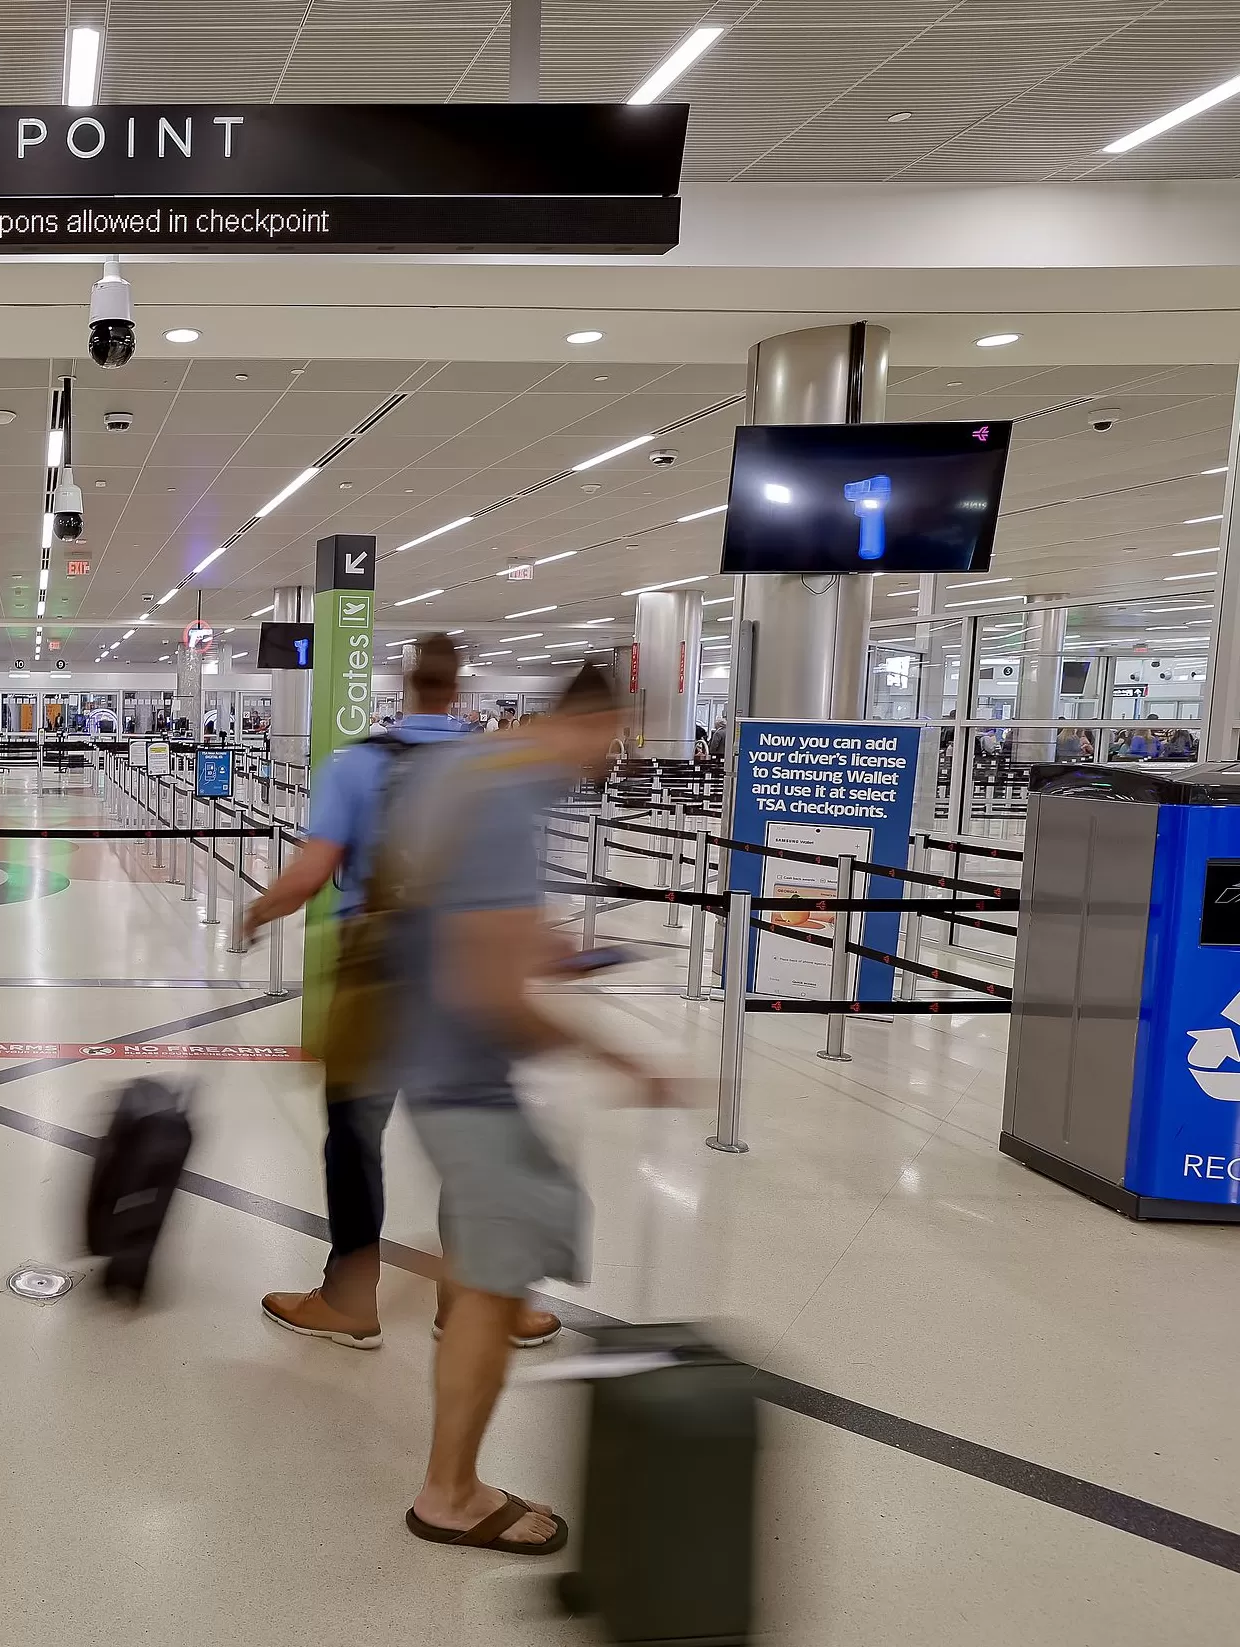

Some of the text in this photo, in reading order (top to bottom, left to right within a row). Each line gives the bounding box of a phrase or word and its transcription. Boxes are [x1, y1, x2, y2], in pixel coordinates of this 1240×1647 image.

[66, 208, 160, 234] allowed
[167, 209, 189, 233] in
[195, 208, 330, 238] checkpoint
[68, 561, 89, 575] EXIT
[336, 633, 370, 735] Gates
[759, 733, 898, 751] Now you can add
[748, 750, 907, 768] your driver's license
[752, 766, 899, 786] to Samsung Wallet
[751, 782, 897, 802] and use it at select
[755, 798, 888, 819] TSA checkpoints.
[167, 1045, 288, 1054] FIREARMS
